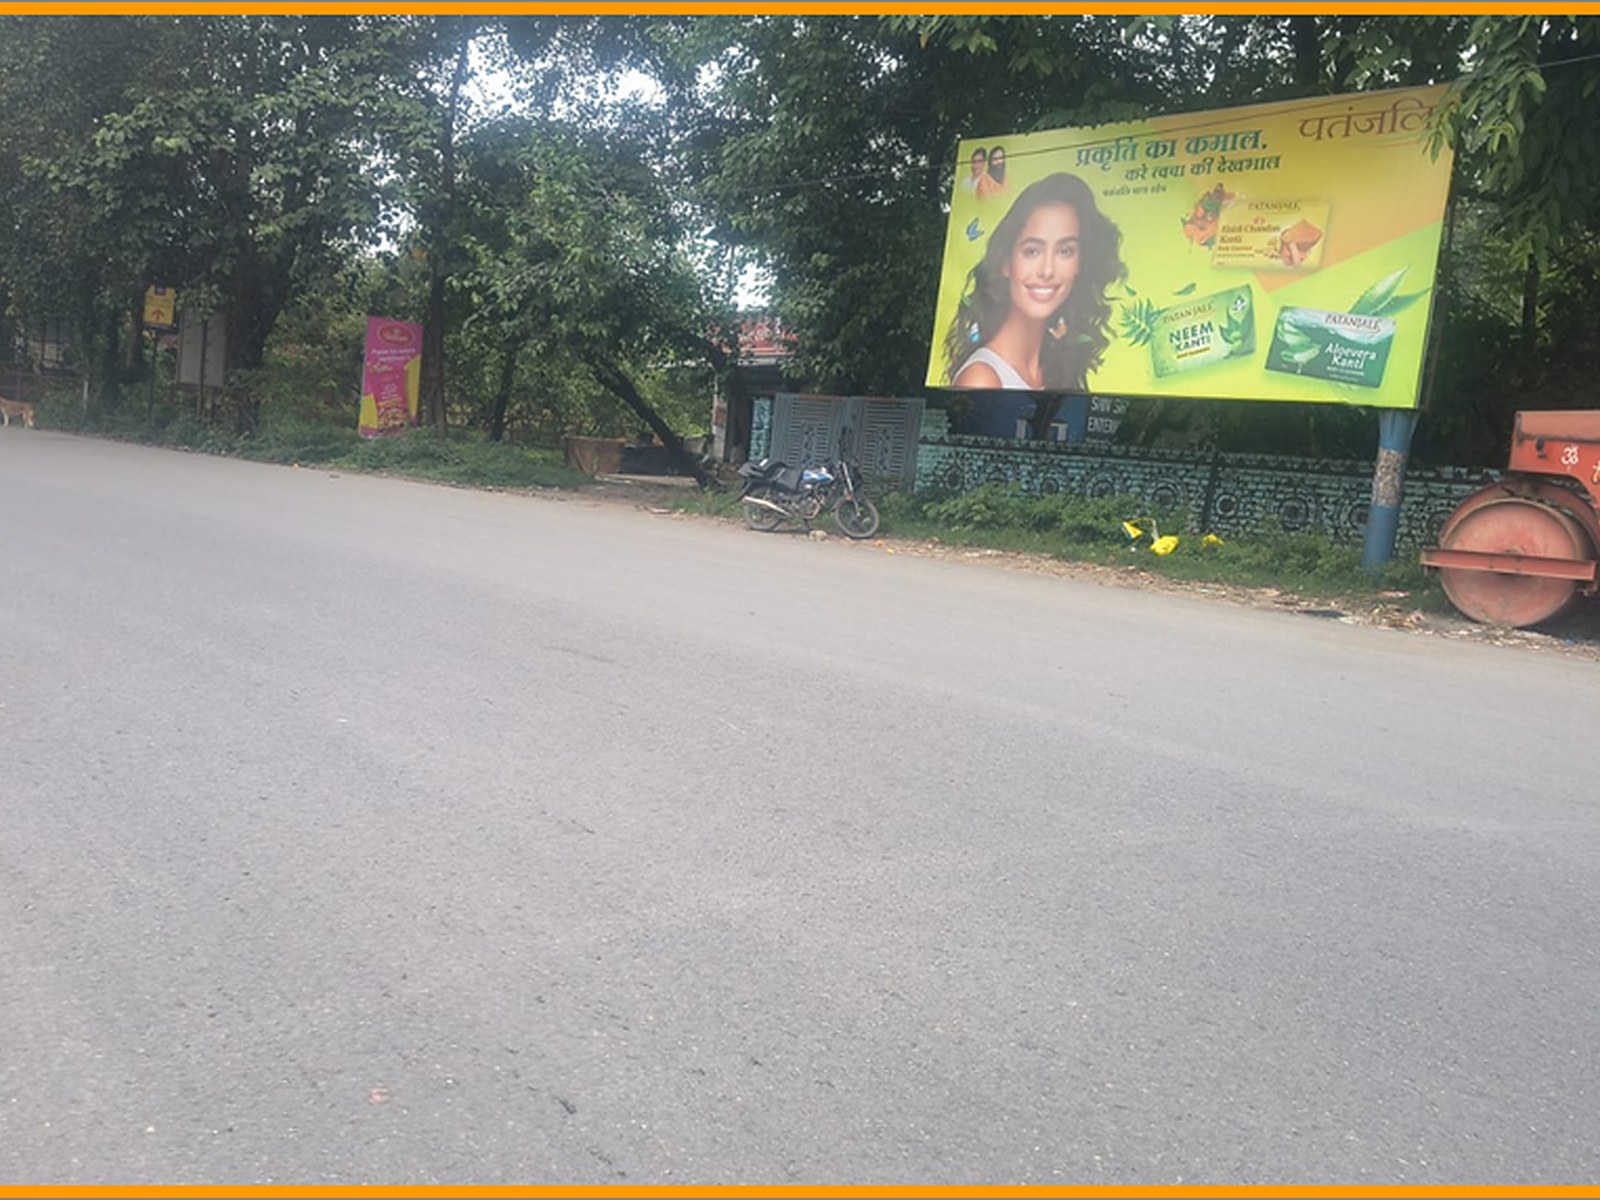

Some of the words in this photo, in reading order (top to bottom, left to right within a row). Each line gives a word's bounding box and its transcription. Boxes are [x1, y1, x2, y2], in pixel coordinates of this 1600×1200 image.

[1299, 97, 1434, 140] पतंजलि
[1076, 137, 1138, 171] प्रकृति
[1145, 139, 1177, 159] का
[1152, 164, 1185, 179] त्वचा
[1190, 157, 1214, 175] की
[1217, 155, 1281, 173] देखभाल
[1169, 321, 1214, 343] NEEM
[1176, 336, 1210, 352] KANTI
[1325, 343, 1377, 360] Aloevera
[1331, 355, 1364, 369] Kanti
